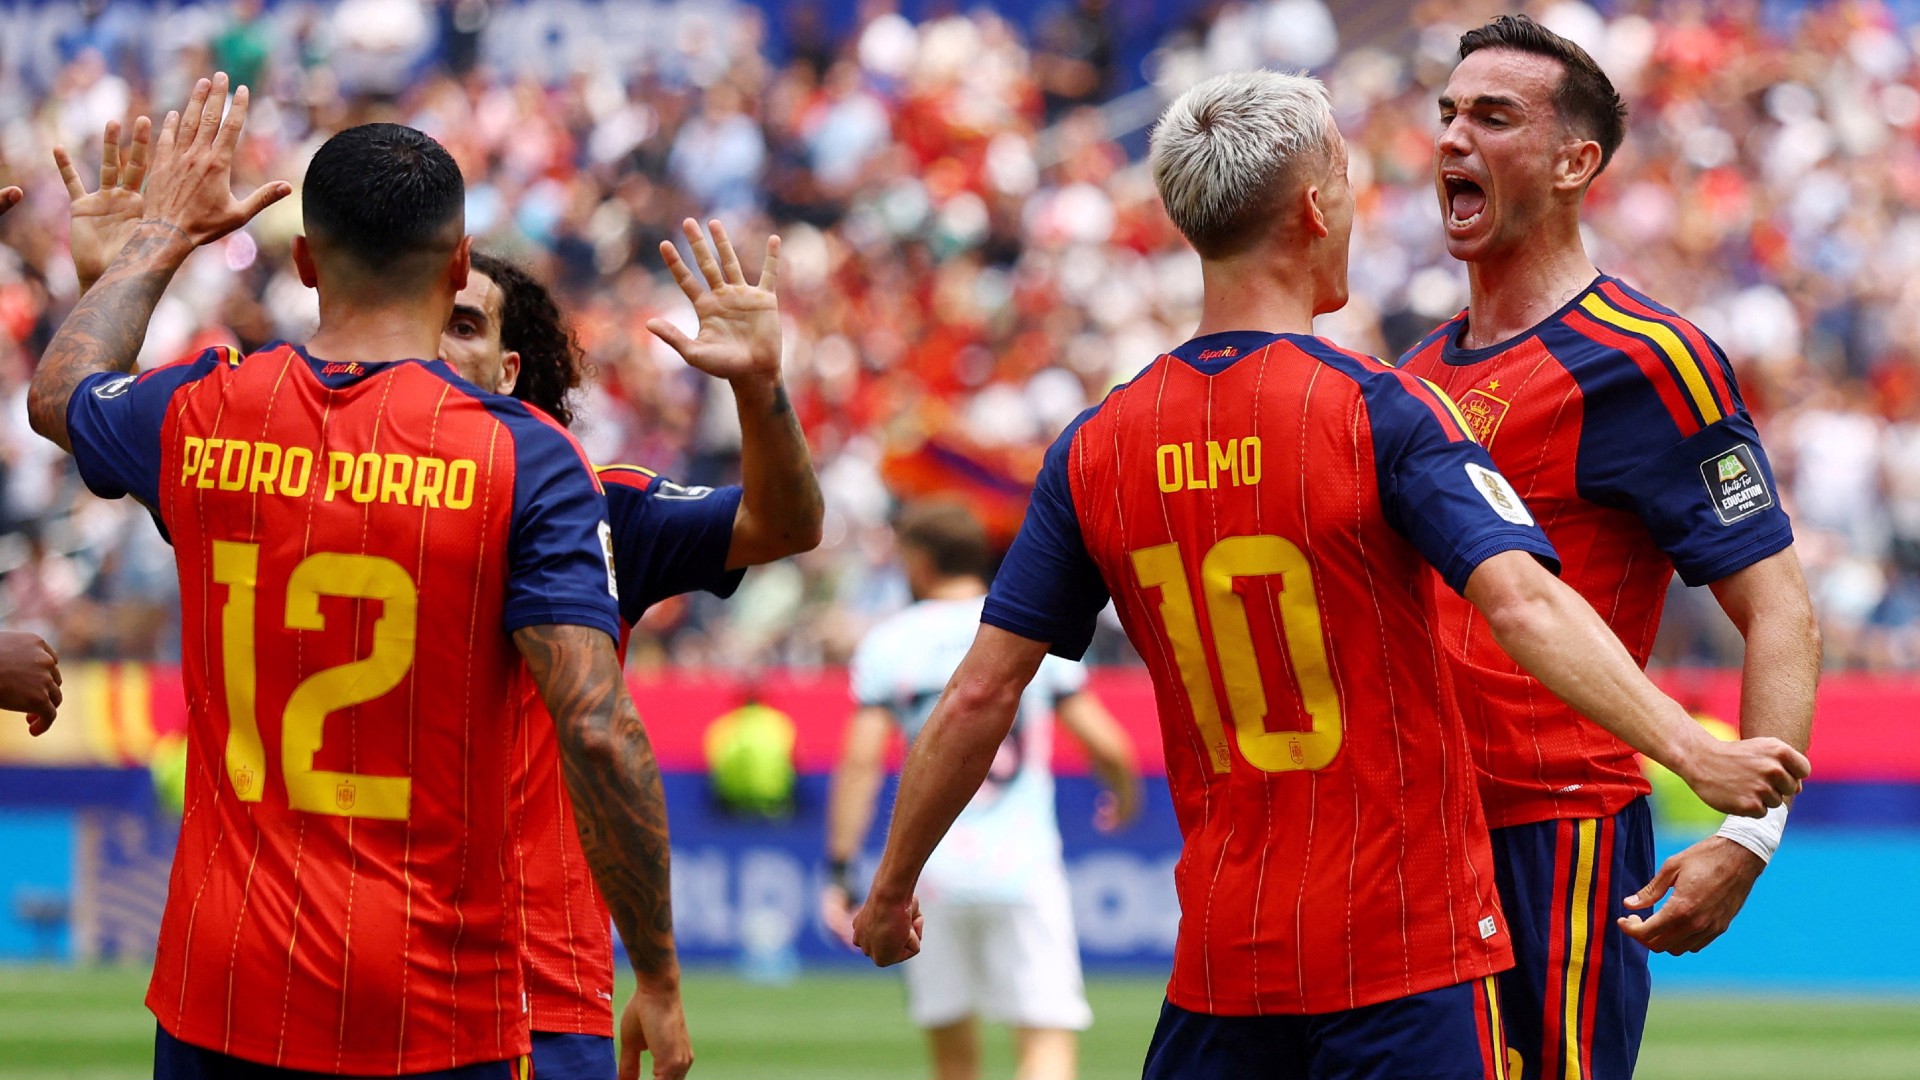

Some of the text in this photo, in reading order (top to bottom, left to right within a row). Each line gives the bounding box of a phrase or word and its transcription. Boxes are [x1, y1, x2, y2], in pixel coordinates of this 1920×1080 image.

[1198, 346, 1239, 361] España
[321, 361, 365, 377] España
[181, 436, 477, 510] PEDRO PORRO
[1156, 436, 1262, 493] OLMO
[1721, 474, 1752, 496] Unite For
[1721, 483, 1763, 510] EDUCATION
[1738, 500, 1755, 511] FIFA
[1129, 535, 1343, 774] 10
[212, 540, 418, 820] 12
